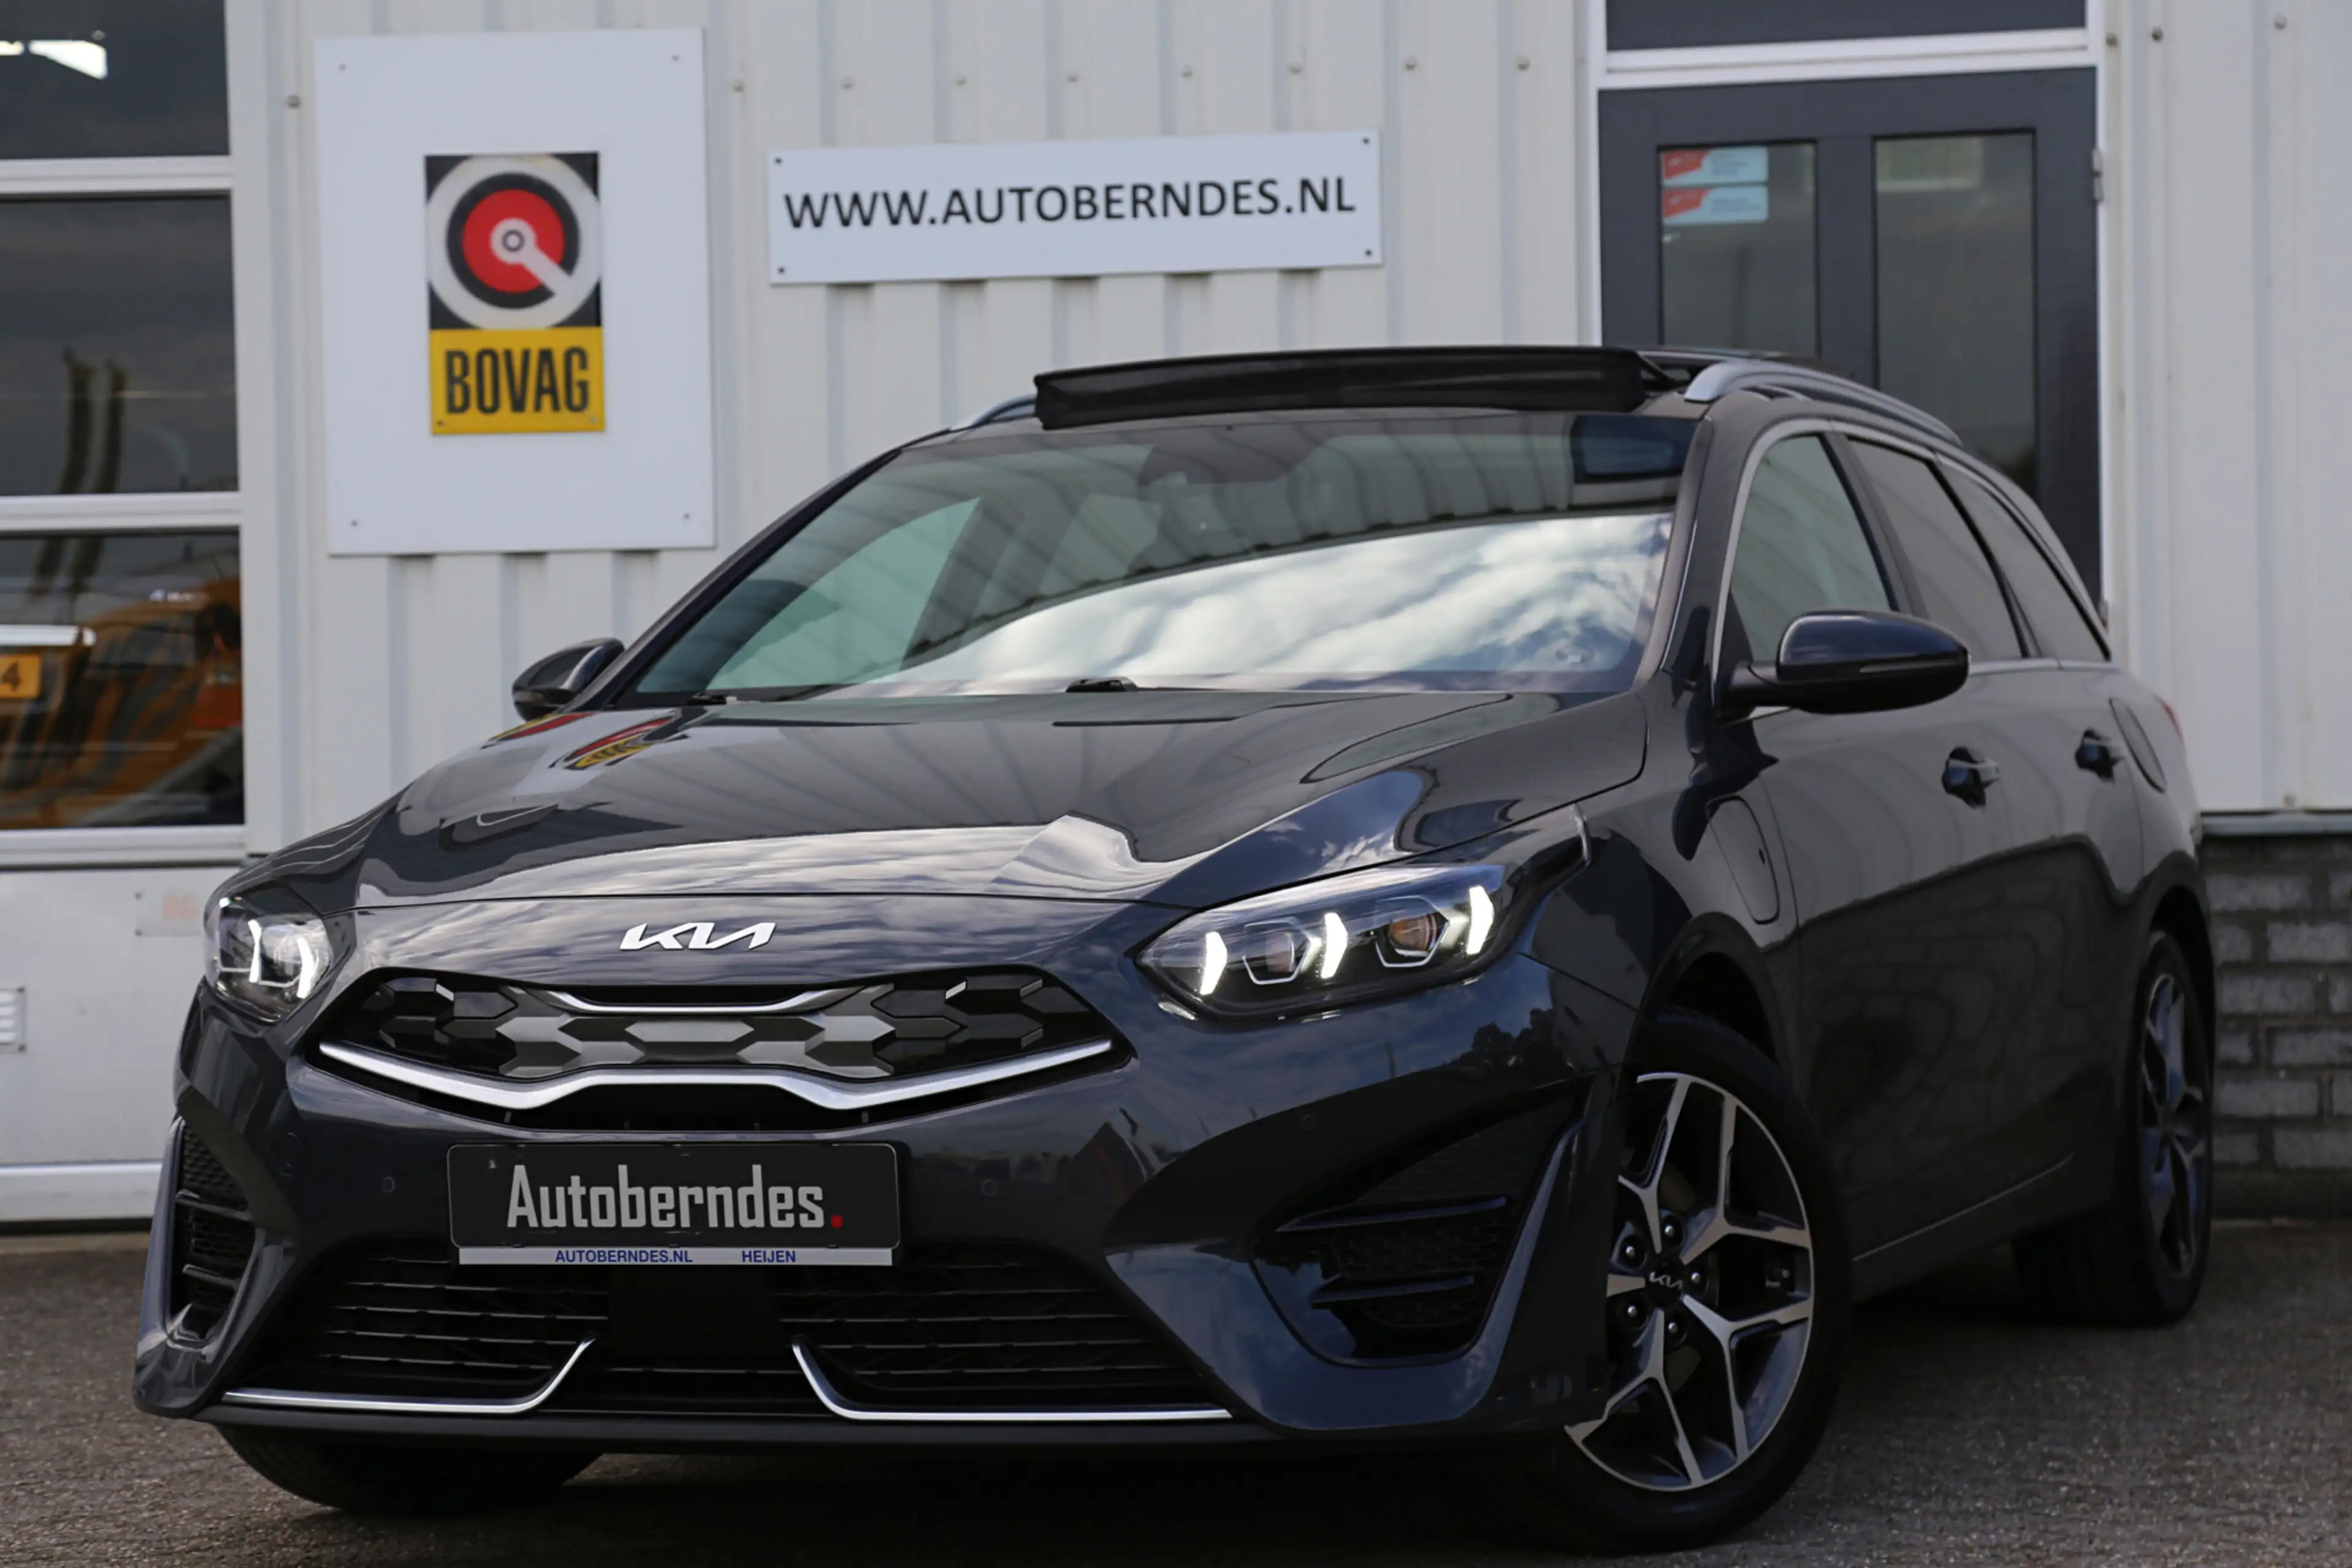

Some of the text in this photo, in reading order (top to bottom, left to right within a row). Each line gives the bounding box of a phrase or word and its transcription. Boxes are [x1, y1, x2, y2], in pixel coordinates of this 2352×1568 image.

[785, 176, 1355, 229] WWW.AUTOBERNDES.NL
[445, 347, 589, 415] BOVAG
[620, 922, 777, 951] KIA
[507, 1164, 843, 1229] Autoberndes.
[555, 1250, 796, 1264] AUTOBERNDES.NL HEIJEN
